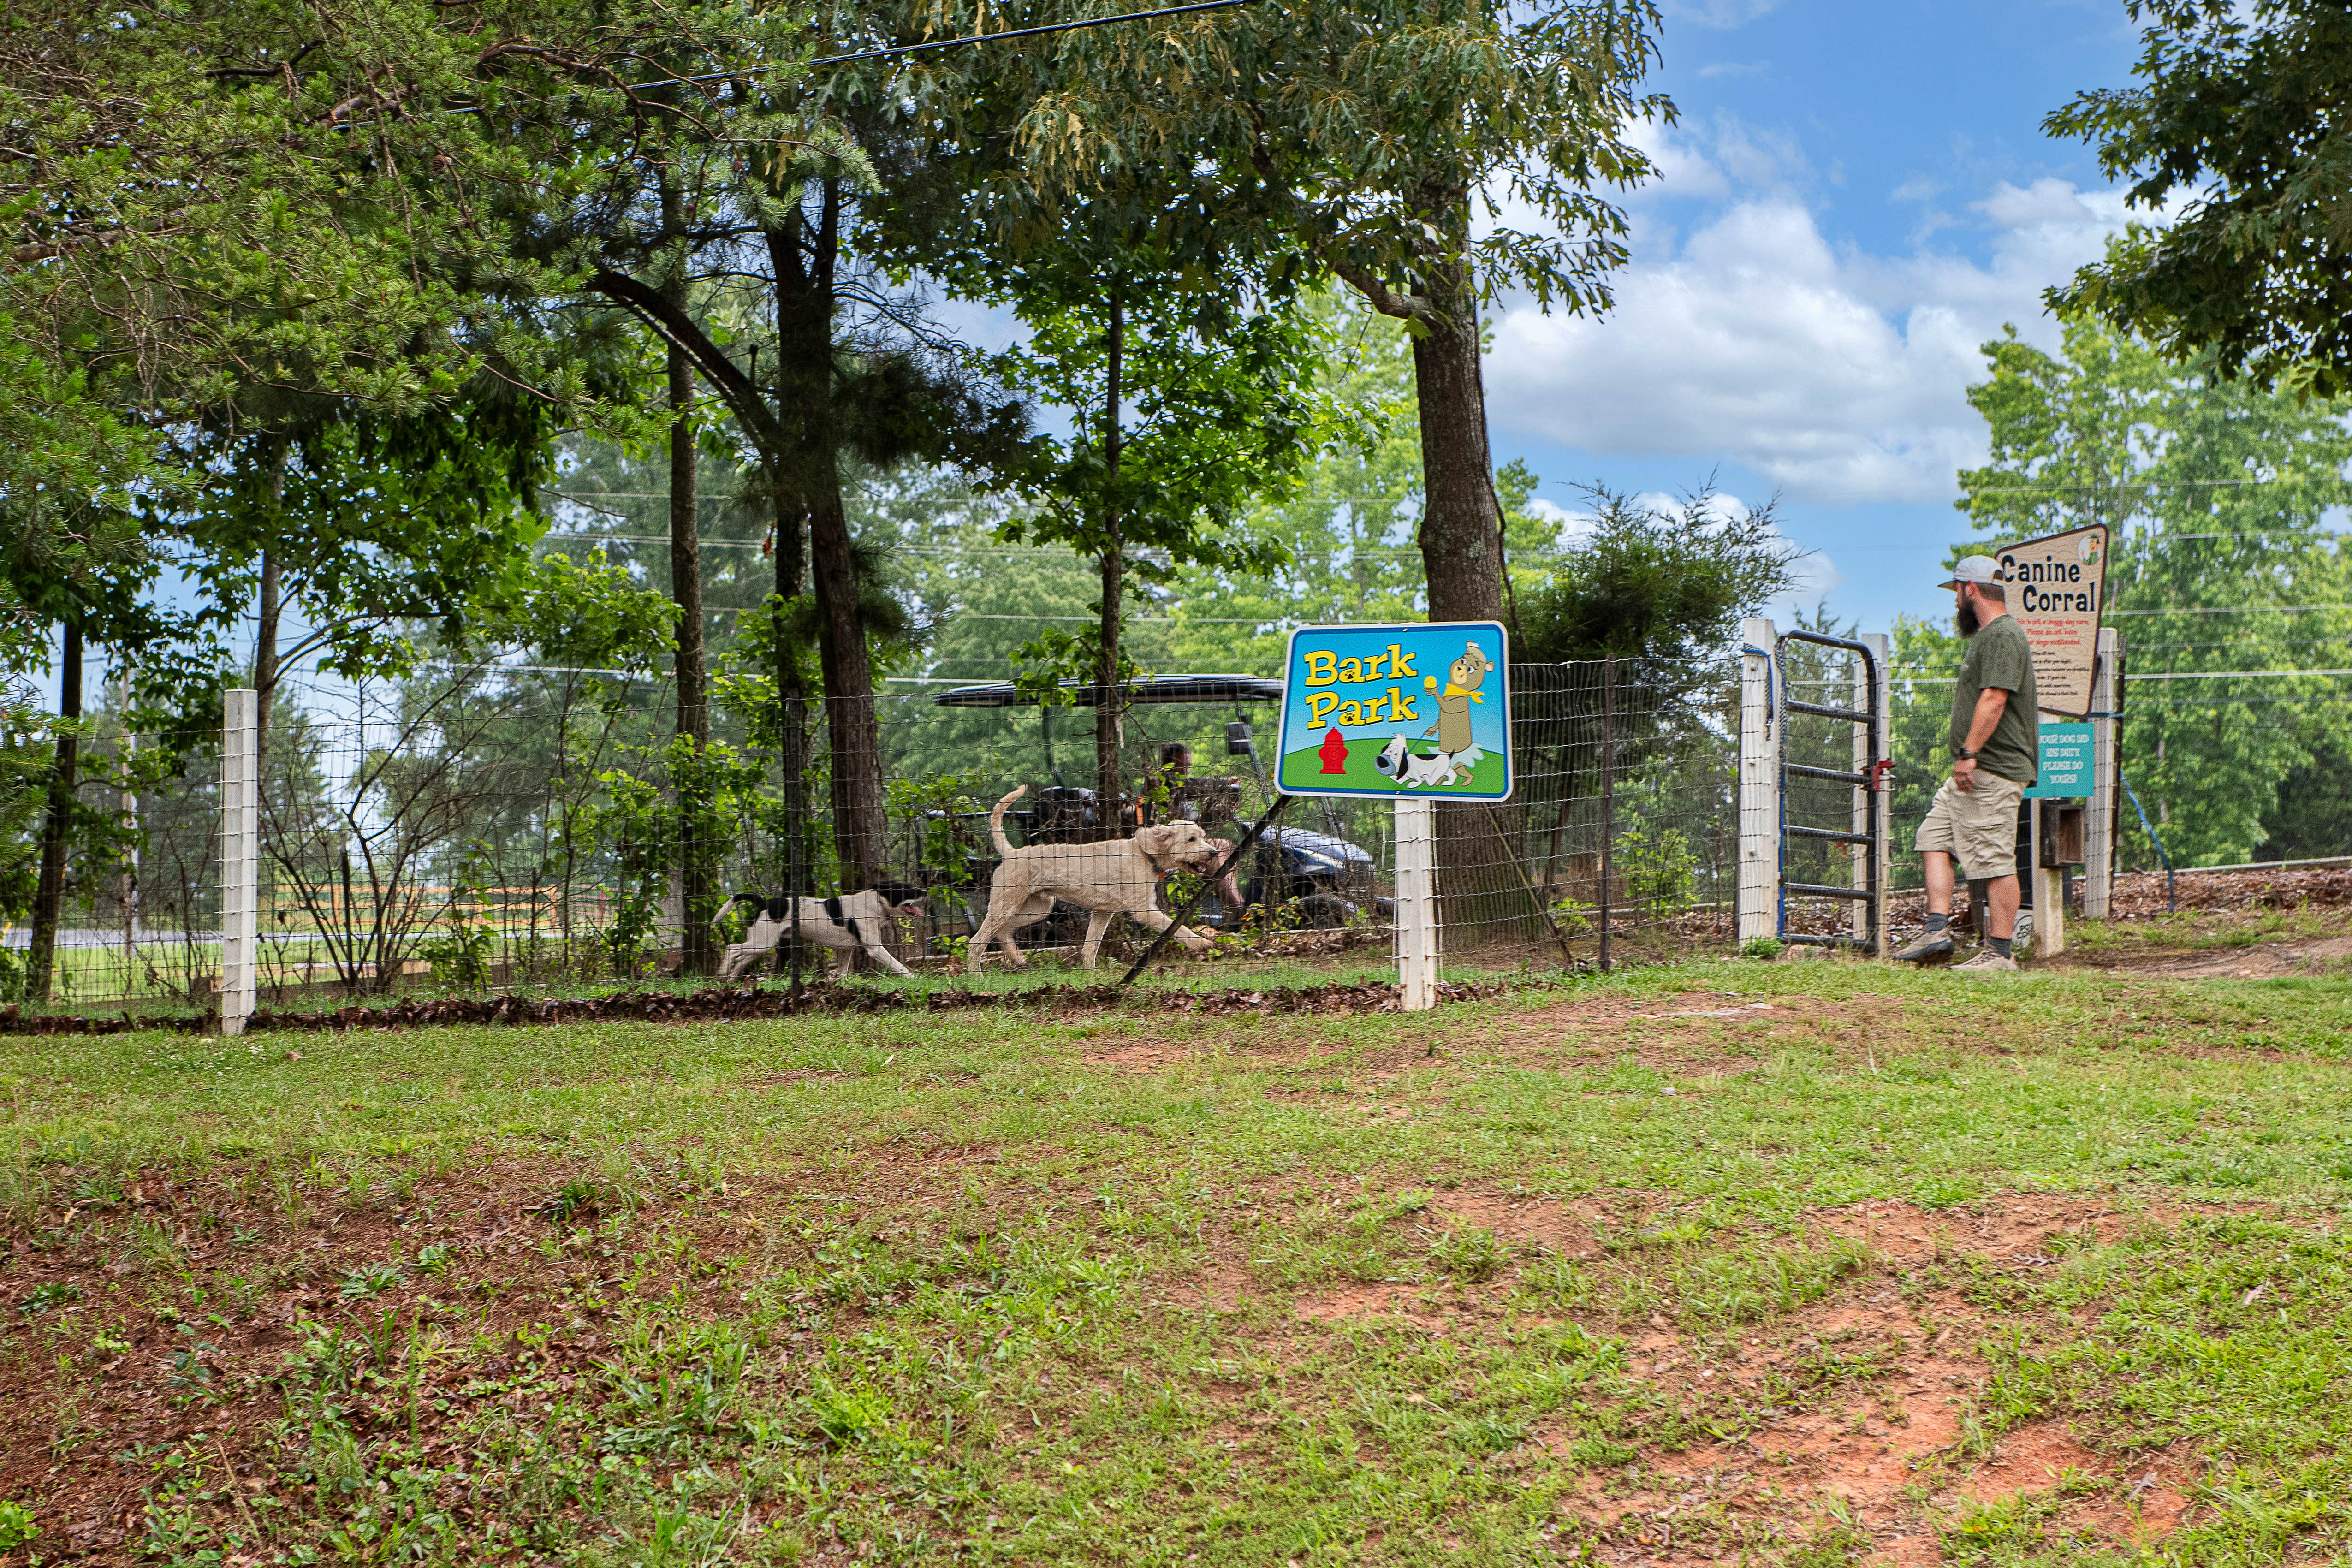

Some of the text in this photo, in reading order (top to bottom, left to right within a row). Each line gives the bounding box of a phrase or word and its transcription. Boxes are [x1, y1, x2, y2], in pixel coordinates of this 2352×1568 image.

[2001, 555, 2081, 583] Canine
[2023, 582, 2096, 612] Corral
[1303, 644, 1418, 687] Bark
[1305, 686, 1418, 730] Park
